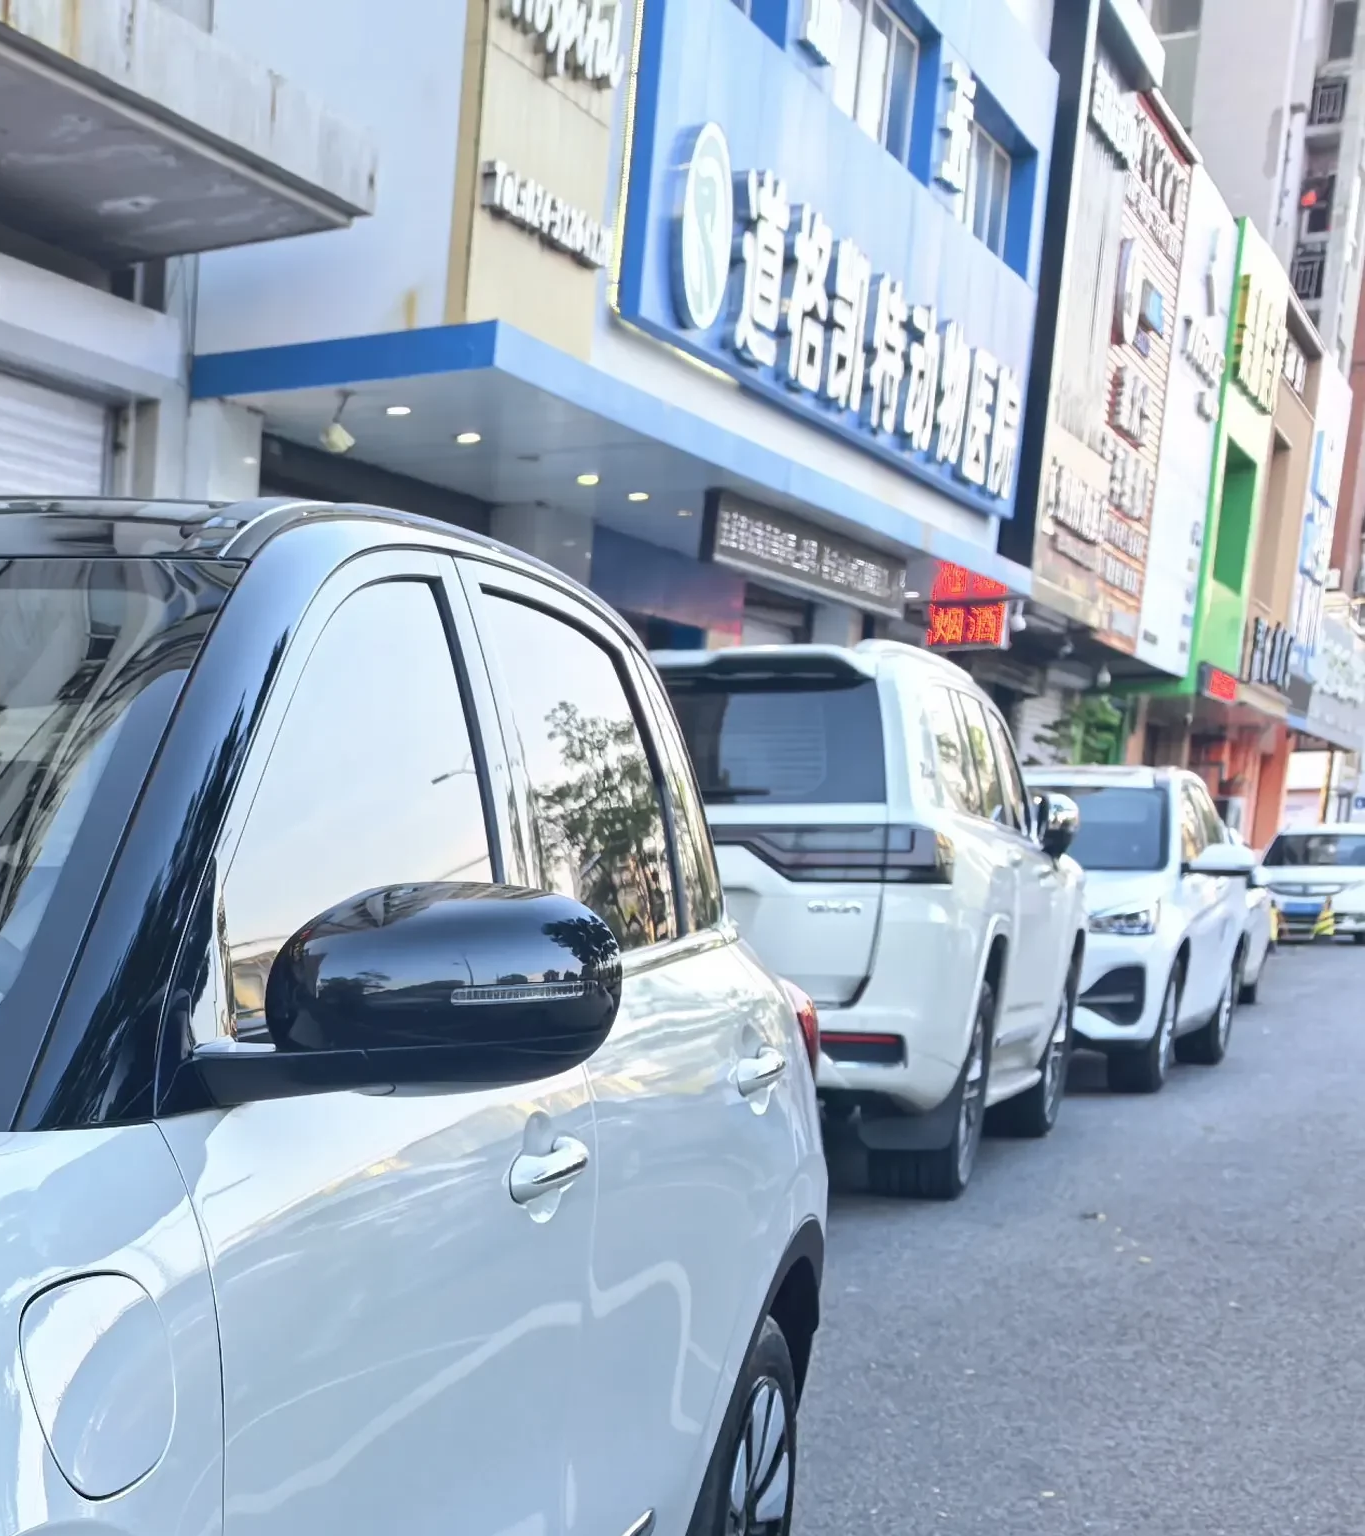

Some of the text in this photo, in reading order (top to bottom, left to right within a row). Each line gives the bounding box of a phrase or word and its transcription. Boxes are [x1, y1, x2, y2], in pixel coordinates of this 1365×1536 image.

[733, 166, 1023, 500] 道格凯特动物医院
[933, 606, 1000, 644] 烟酒
